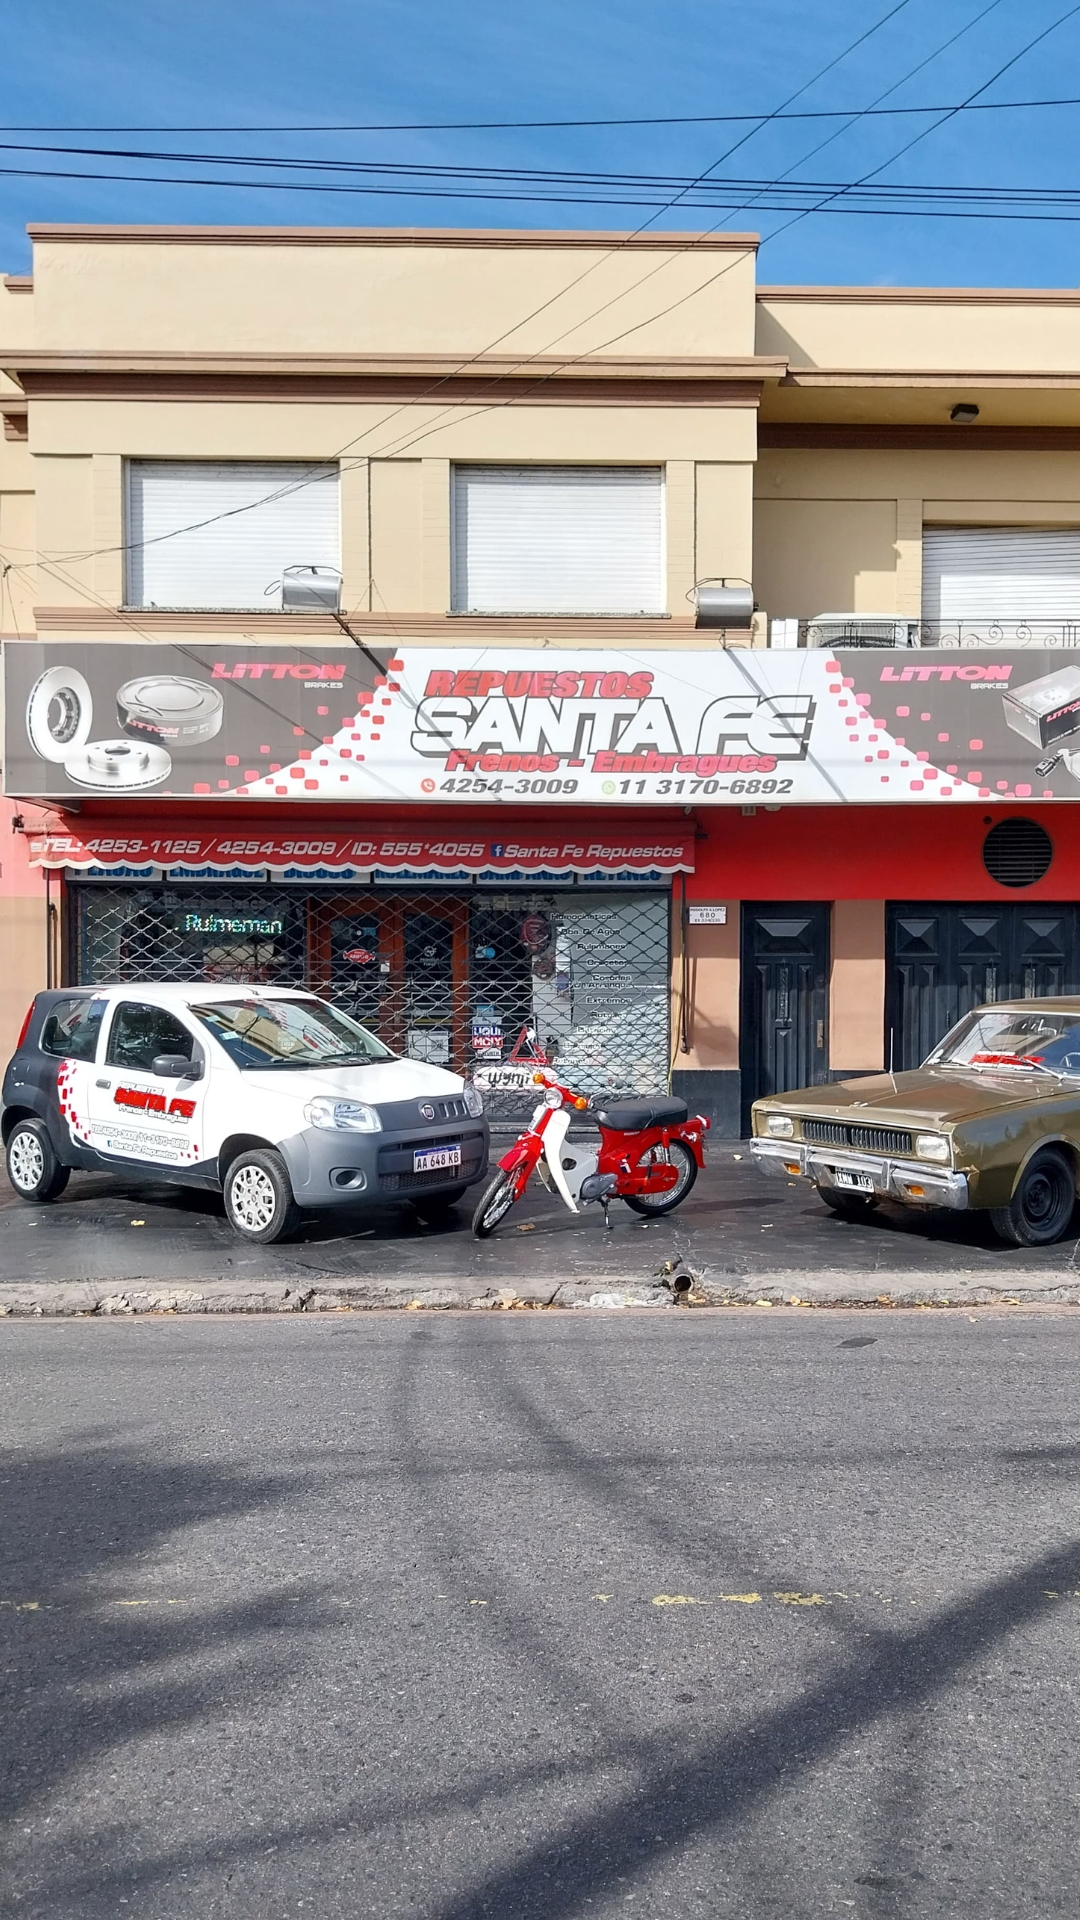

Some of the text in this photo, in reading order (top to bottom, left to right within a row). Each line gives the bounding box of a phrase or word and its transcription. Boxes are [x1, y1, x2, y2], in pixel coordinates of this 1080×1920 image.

[304, 681, 344, 689] BRAKES
[423, 669, 654, 698] REPUESTOS
[970, 682, 1009, 690] BRAKES
[410, 694, 817, 761] SANTA FE
[444, 748, 560, 773] Frenos
[591, 749, 778, 778] Embragues
[440, 778, 794, 795] 4254-3009 11 3170-6892
[85, 838, 201, 855] 4253-1125
[217, 841, 337, 855] 4254-3009
[351, 842, 378, 856] ID:
[504, 844, 559, 858] Santa
[561, 844, 584, 858] Fe
[586, 844, 683, 861] Repuestos
[417, 1157, 428, 1170] AA
[431, 1154, 446, 1167] 648
[448, 1151, 459, 1164] KB
